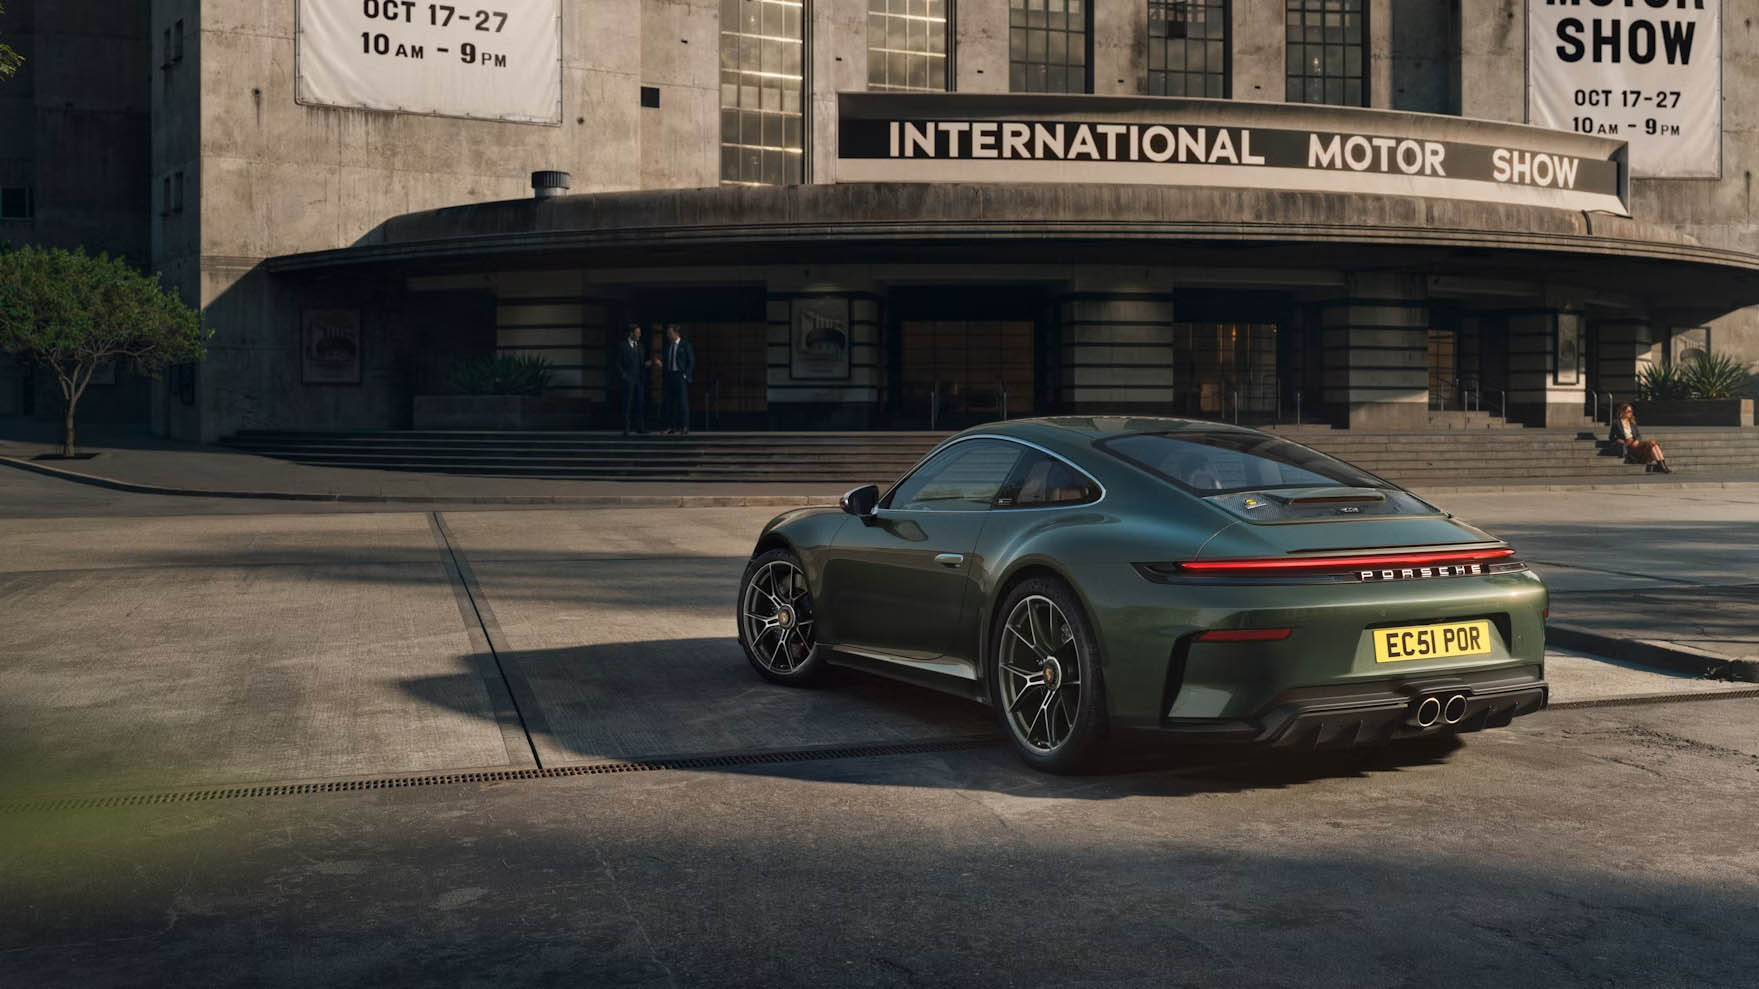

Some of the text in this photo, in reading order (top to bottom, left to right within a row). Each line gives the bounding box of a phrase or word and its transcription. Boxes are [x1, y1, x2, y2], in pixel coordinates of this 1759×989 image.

[362, 0, 508, 33] OCT 17-27
[1555, 17, 1696, 65] SHOW
[1574, 89, 1681, 109] OCT 17-27
[889, 121, 1579, 189] INTERNATIONAL MOTOR SHOW
[1360, 564, 1482, 582] PORSCHE
[1386, 626, 1481, 658] EC51 POR
